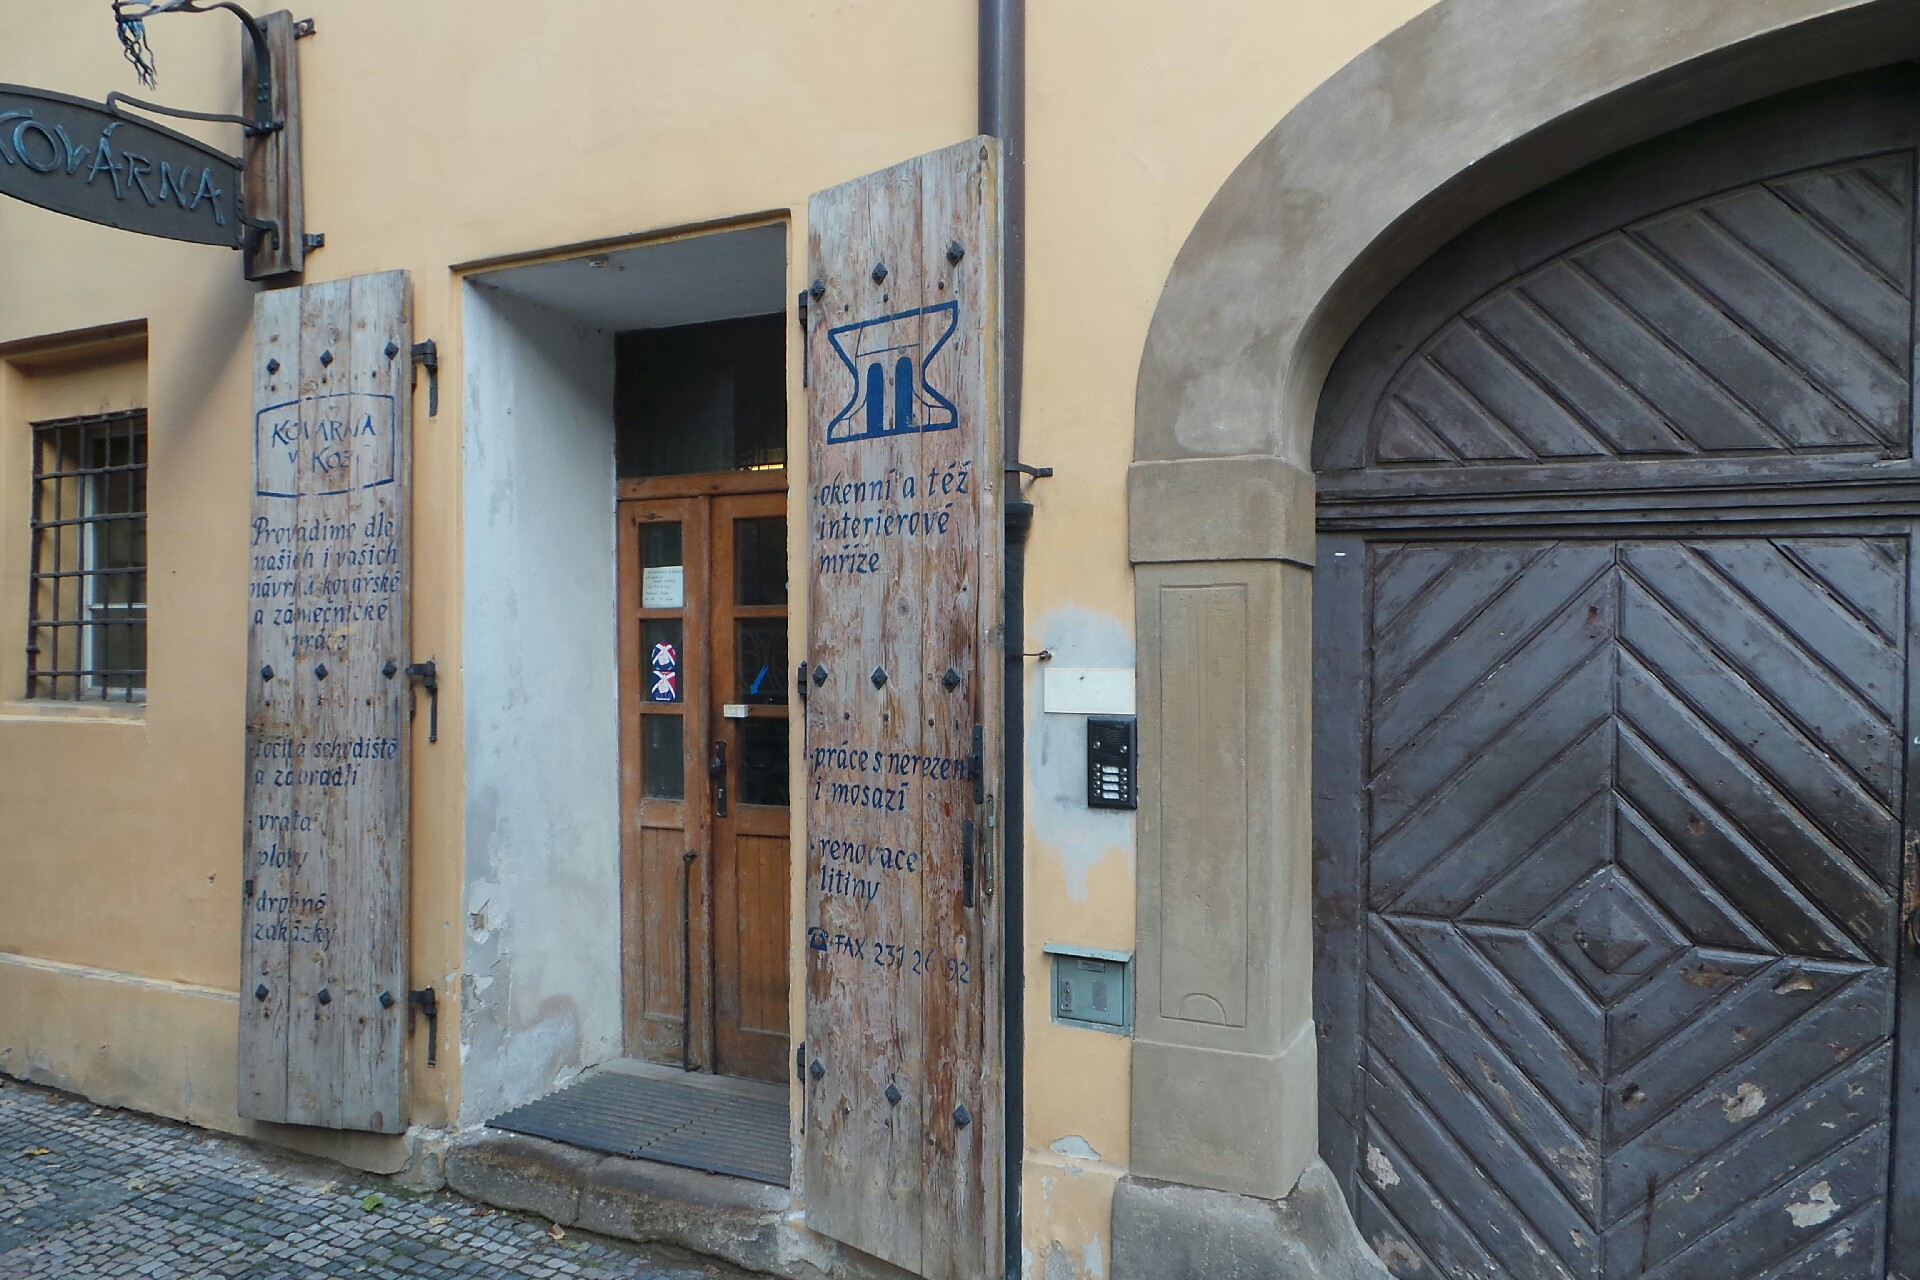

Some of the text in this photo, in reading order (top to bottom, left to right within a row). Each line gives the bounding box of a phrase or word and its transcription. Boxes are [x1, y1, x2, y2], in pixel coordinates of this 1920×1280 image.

[902, 476, 916, 499] a
[928, 460, 971, 497] též
[364, 512, 394, 538] dle
[324, 547, 330, 568] i
[335, 541, 397, 567] vašich
[254, 608, 264, 625] a
[814, 740, 869, 773] práce
[872, 750, 883, 773] s
[255, 769, 265, 785] a
[815, 775, 822, 801] i
[259, 810, 311, 832] vrata
[820, 838, 918, 873] renovace
[874, 942, 905, 968] 231
[945, 958, 969, 984] 92
